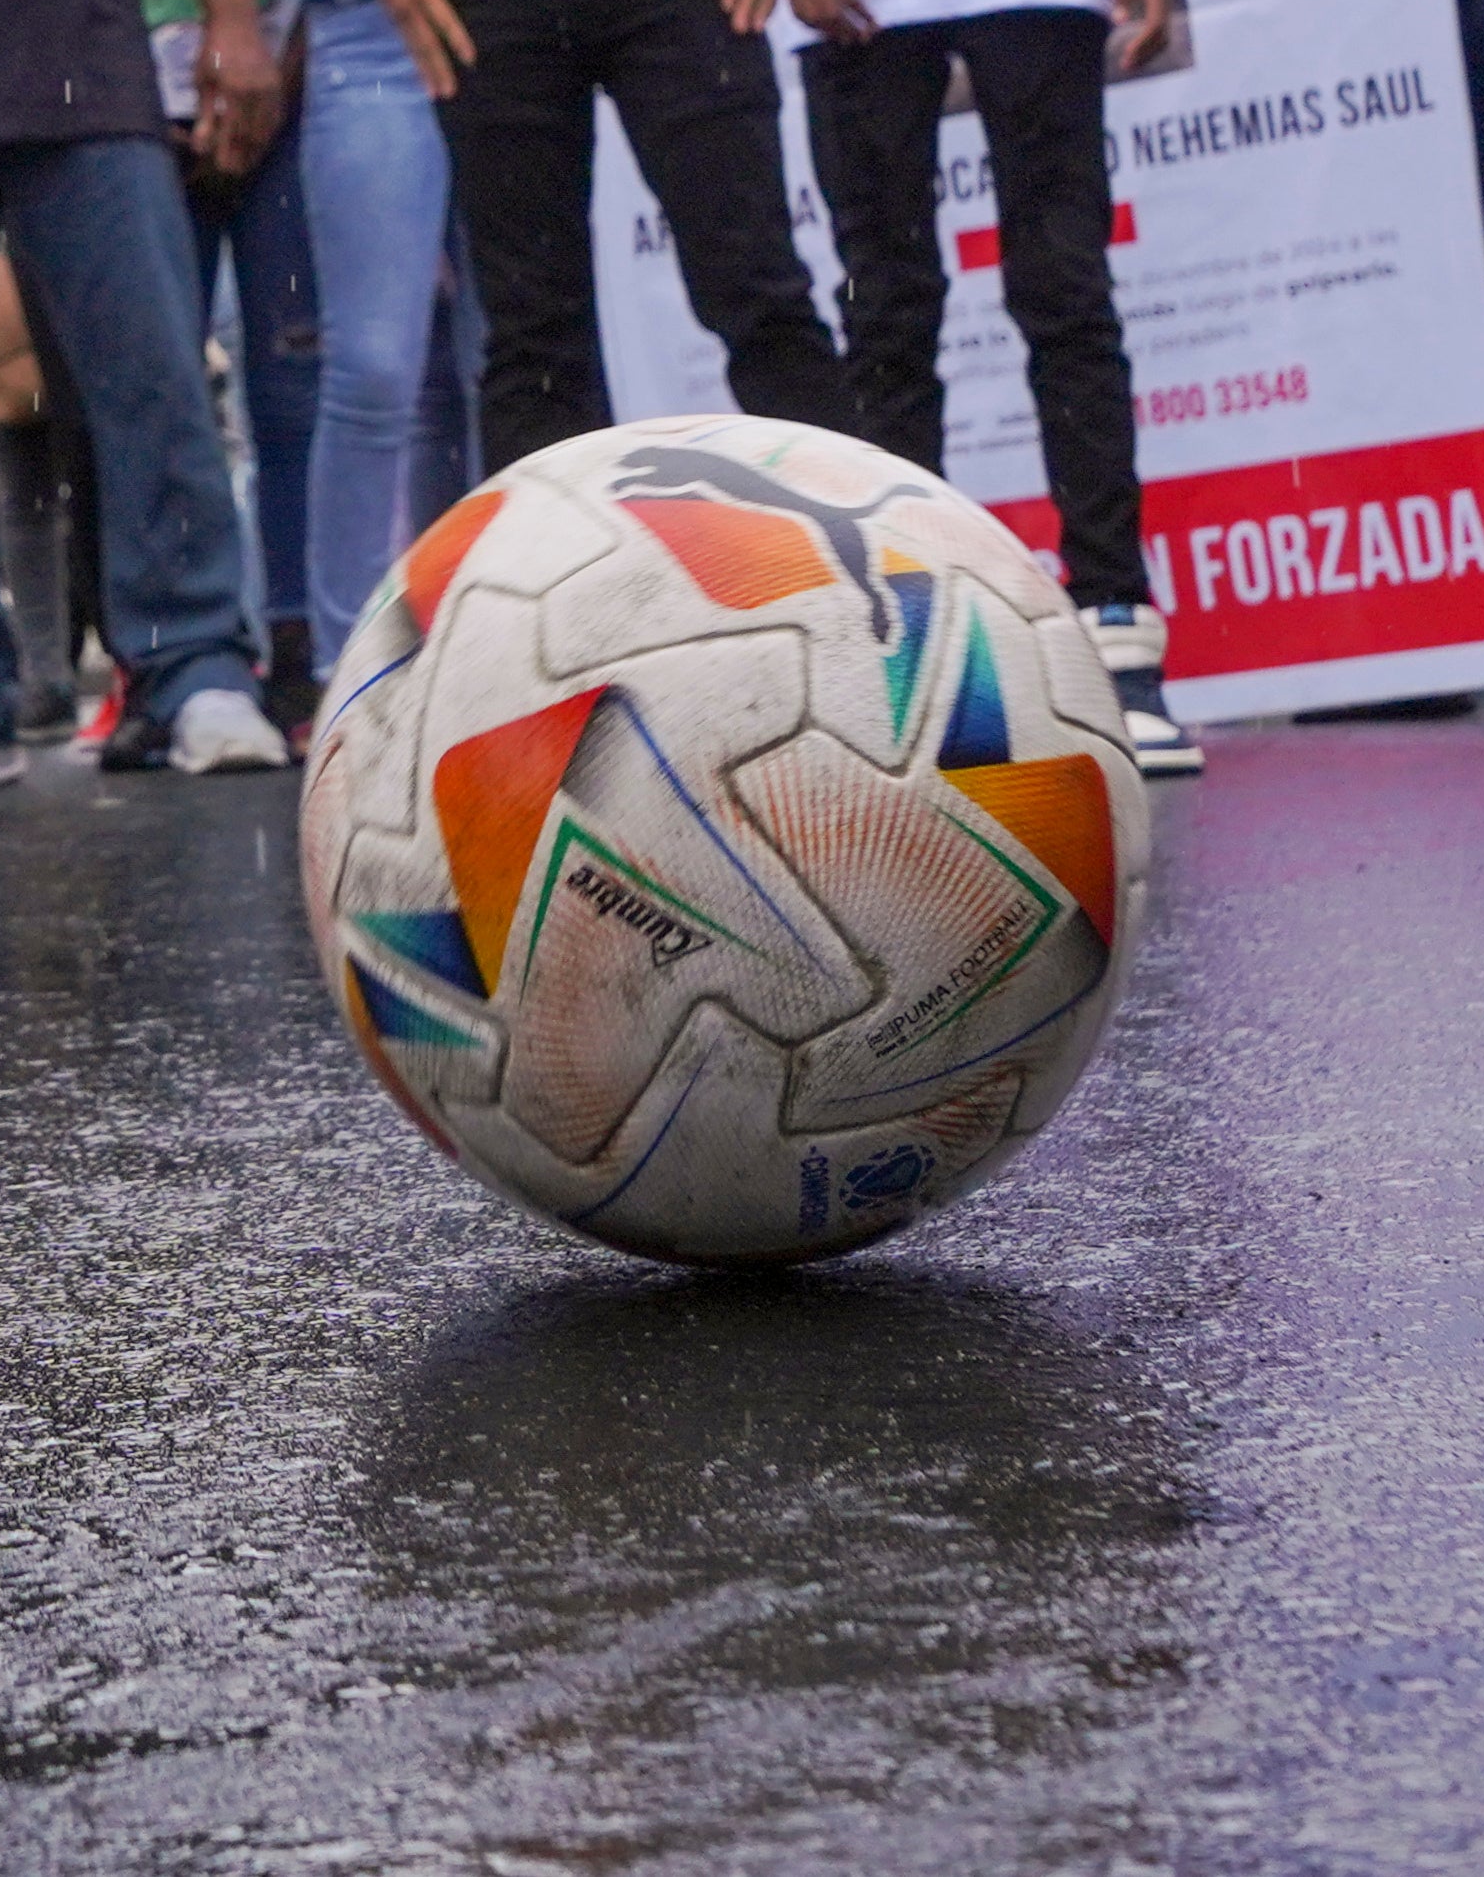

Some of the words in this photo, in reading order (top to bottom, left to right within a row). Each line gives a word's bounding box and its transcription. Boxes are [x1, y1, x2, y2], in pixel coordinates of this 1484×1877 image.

[1132, 86, 1327, 168] NEHEMIAS
[1336, 67, 1436, 129] SAUL
[893, 983, 951, 1032] PUMA
